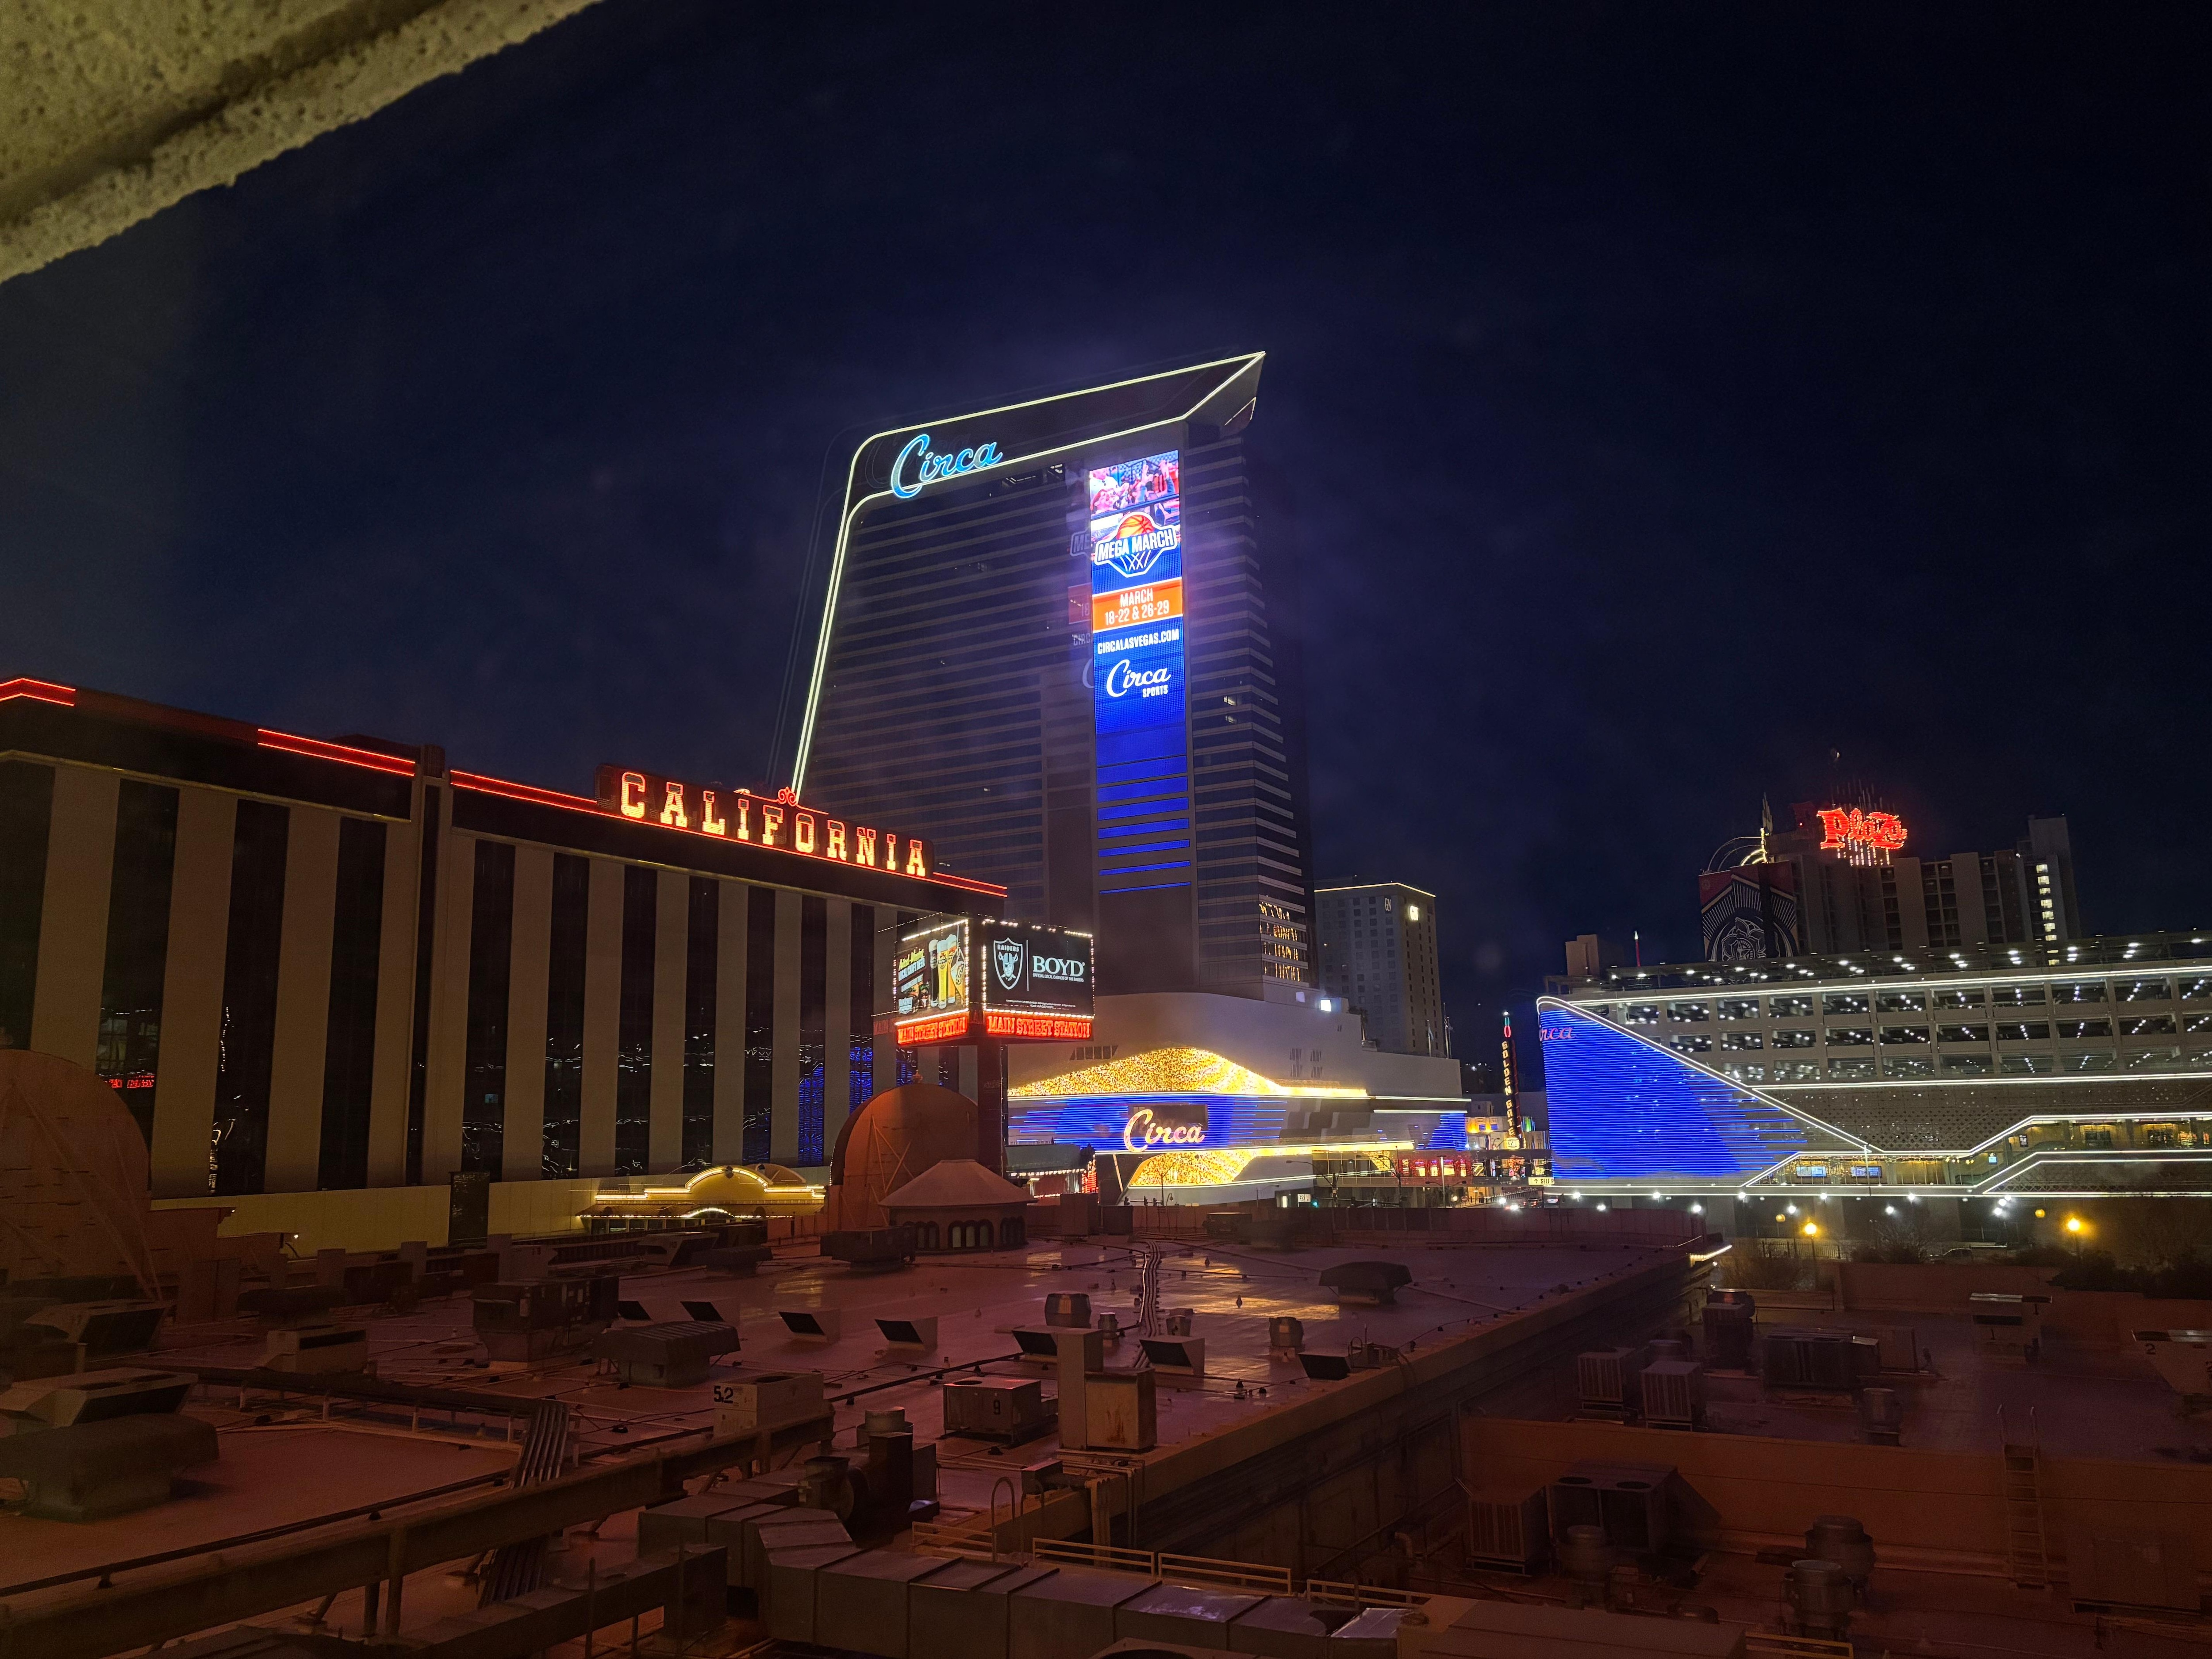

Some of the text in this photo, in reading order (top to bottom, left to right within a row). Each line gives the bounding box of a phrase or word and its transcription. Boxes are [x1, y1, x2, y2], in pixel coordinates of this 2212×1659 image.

[891, 434, 1003, 498] Circa
[1098, 538, 1129, 561] MEGA
[1132, 529, 1174, 553] MARCH
[1120, 588, 1153, 607] MARCH
[1105, 606, 1129, 626] 18-22
[1133, 607, 1139, 619] &
[1141, 600, 1169, 618] 26-29
[1098, 629, 1179, 654] CIRCALASVEGAS.COM
[1106, 659, 1171, 698] Circa
[1142, 685, 1168, 698] SPORTS
[621, 772, 926, 877] CALIFORNIA
[1816, 807, 1908, 849] Plaza
[1032, 955, 1084, 977] BOYD
[987, 1016, 1090, 1038] MAIN STREET STATION
[1502, 1041, 1511, 1095] GOLDEN
[1124, 1109, 1205, 1152] Circa
[1505, 1099, 1516, 1136] GATE
[2146, 1343, 2156, 1355] 2
[993, 1399, 1000, 1415] 9
